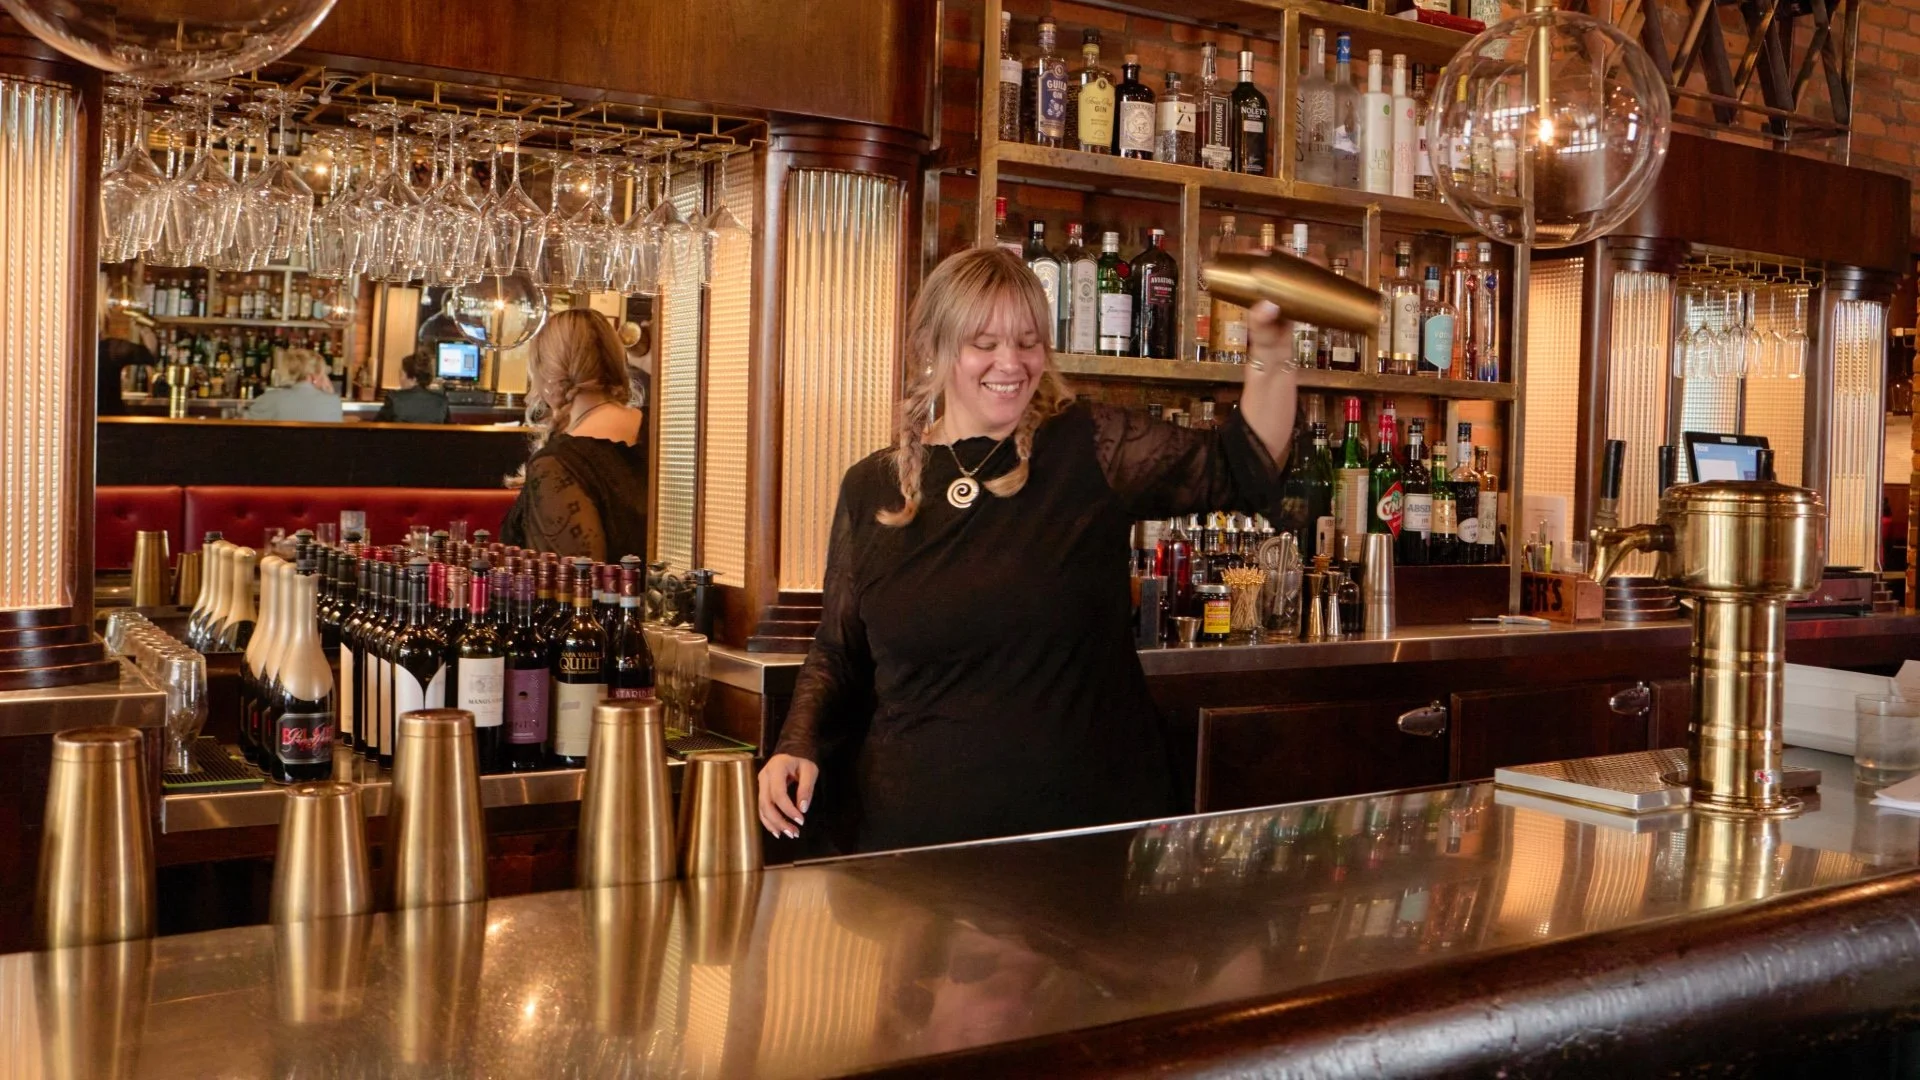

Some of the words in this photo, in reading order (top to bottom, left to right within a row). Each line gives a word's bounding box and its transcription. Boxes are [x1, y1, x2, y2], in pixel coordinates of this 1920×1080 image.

[1046, 79, 1067, 91] GUILD
[1094, 105, 1107, 113] GIN
[1241, 106, 1267, 116] NOLET'S
[1215, 103, 1223, 142] STATEHOUSE
[559, 657, 602, 671] QUILT
